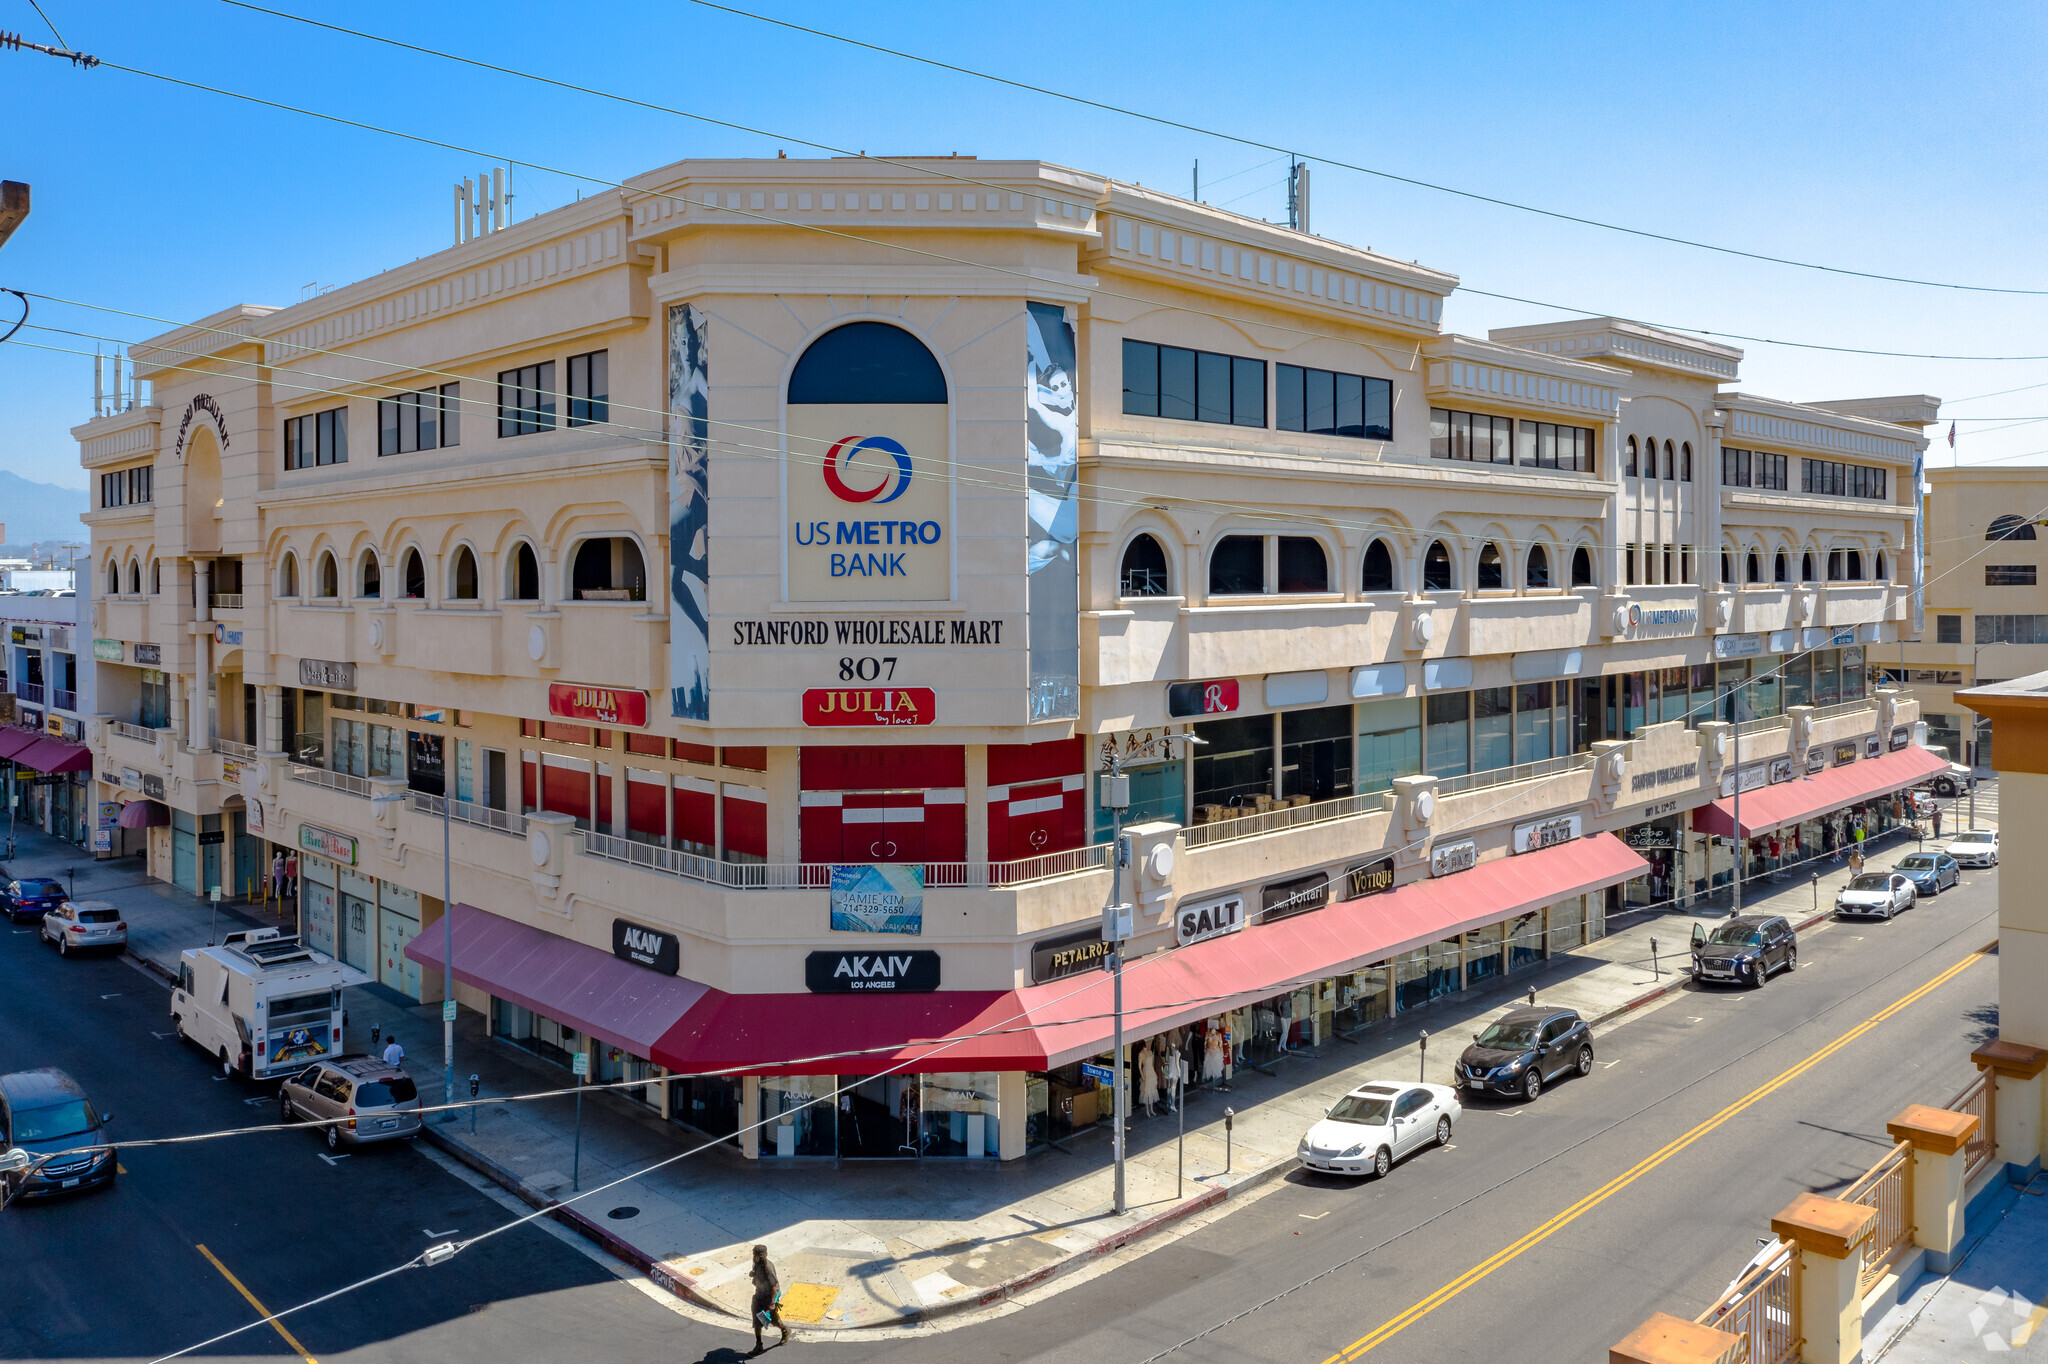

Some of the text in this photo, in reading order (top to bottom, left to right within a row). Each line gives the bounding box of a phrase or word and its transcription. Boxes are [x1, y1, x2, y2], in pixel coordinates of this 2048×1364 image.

[796, 520, 942, 546] US METRO
[830, 553, 907, 577] BANK
[1641, 608, 1697, 626] US METRO BANK
[733, 620, 1003, 645] STANFORD WHOLESALE MART
[838, 656, 898, 682] 807
[573, 689, 617, 711] JULIA
[818, 691, 918, 713] JULIA
[1205, 684, 1228, 712] R
[875, 712, 889, 725] by
[102, 771, 121, 786] PARKING
[1632, 762, 1697, 793] STANFORD WHOLESALE MART
[1540, 827, 1572, 846] BAZI
[1629, 834, 1671, 846] Secret
[1639, 827, 1664, 837] Top
[843, 893, 904, 906] JAMIE KIM
[843, 903, 904, 915] 714-329-5650
[1182, 900, 1239, 937] SALT
[623, 927, 663, 956] AKAIV
[1053, 941, 1110, 968] PETALROZ
[833, 955, 913, 978] AKAIV
[851, 981, 896, 989] LOS ANGELES
[1087, 1066, 1102, 1076] Towne
